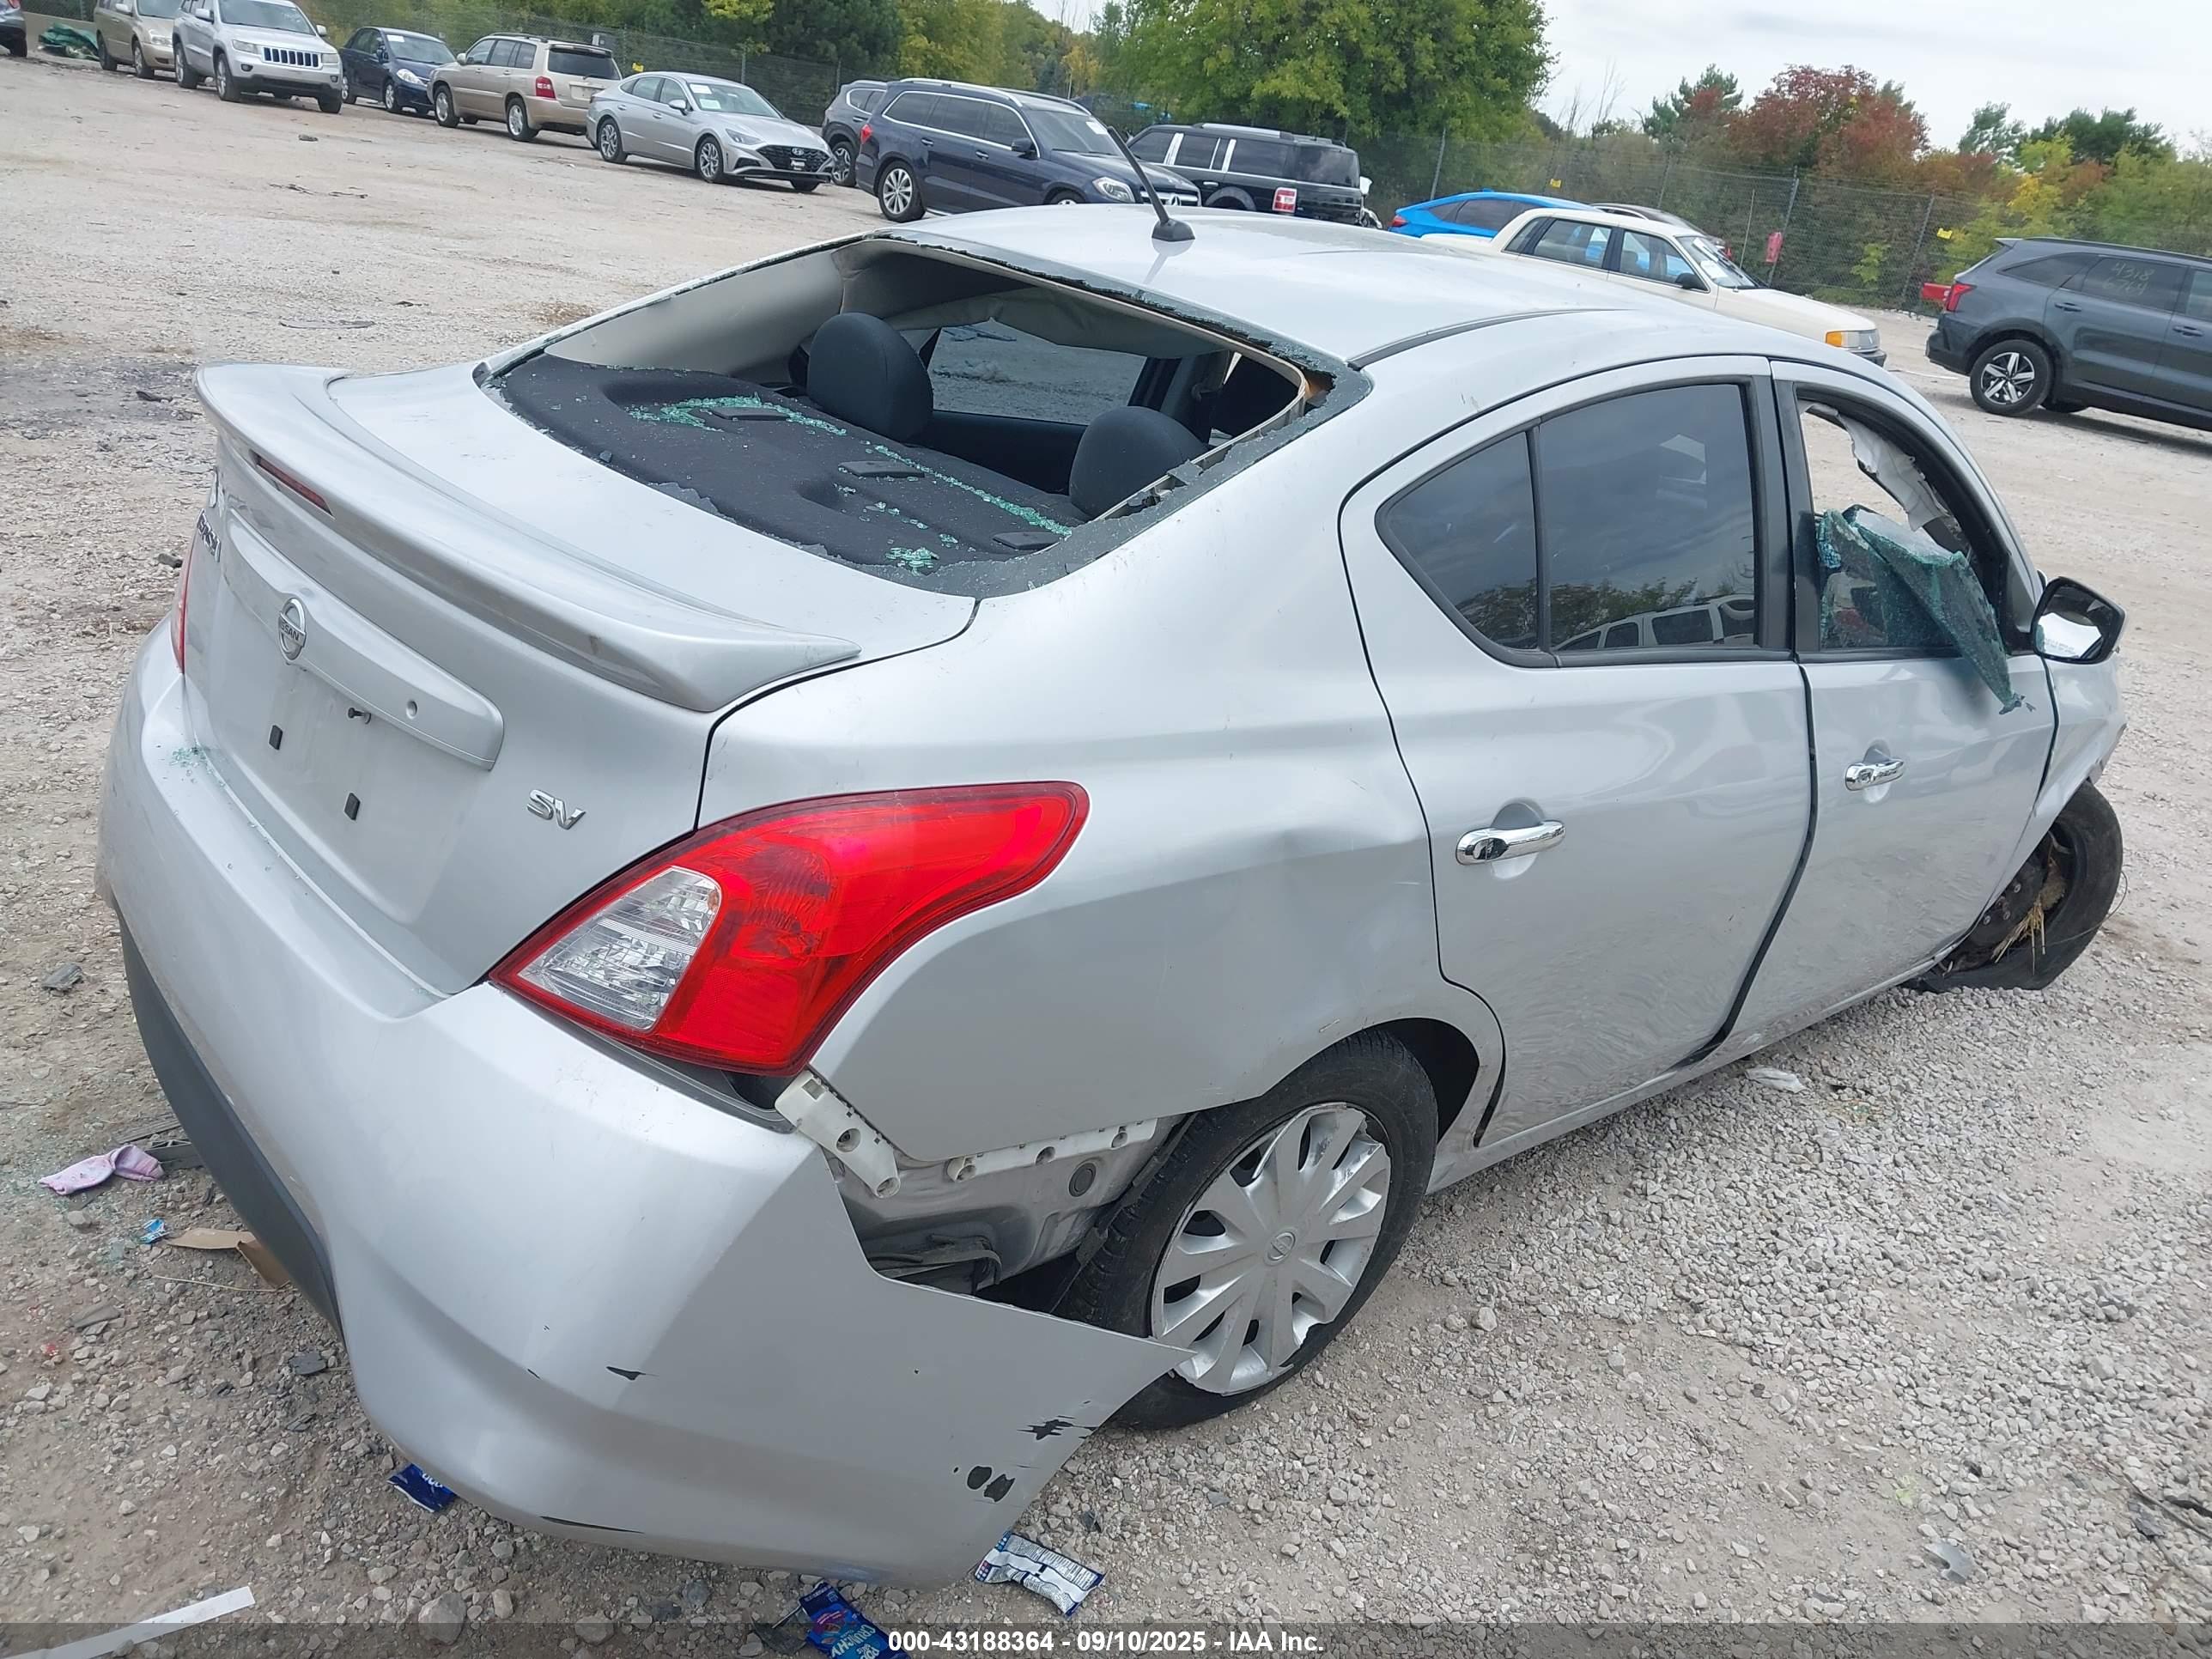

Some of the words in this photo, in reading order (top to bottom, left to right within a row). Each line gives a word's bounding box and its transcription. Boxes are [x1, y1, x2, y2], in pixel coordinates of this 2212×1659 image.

[281, 617, 300, 641] SSAN
[526, 789, 586, 830] SV
[830, 1623, 877, 1658] CRUNCHY
